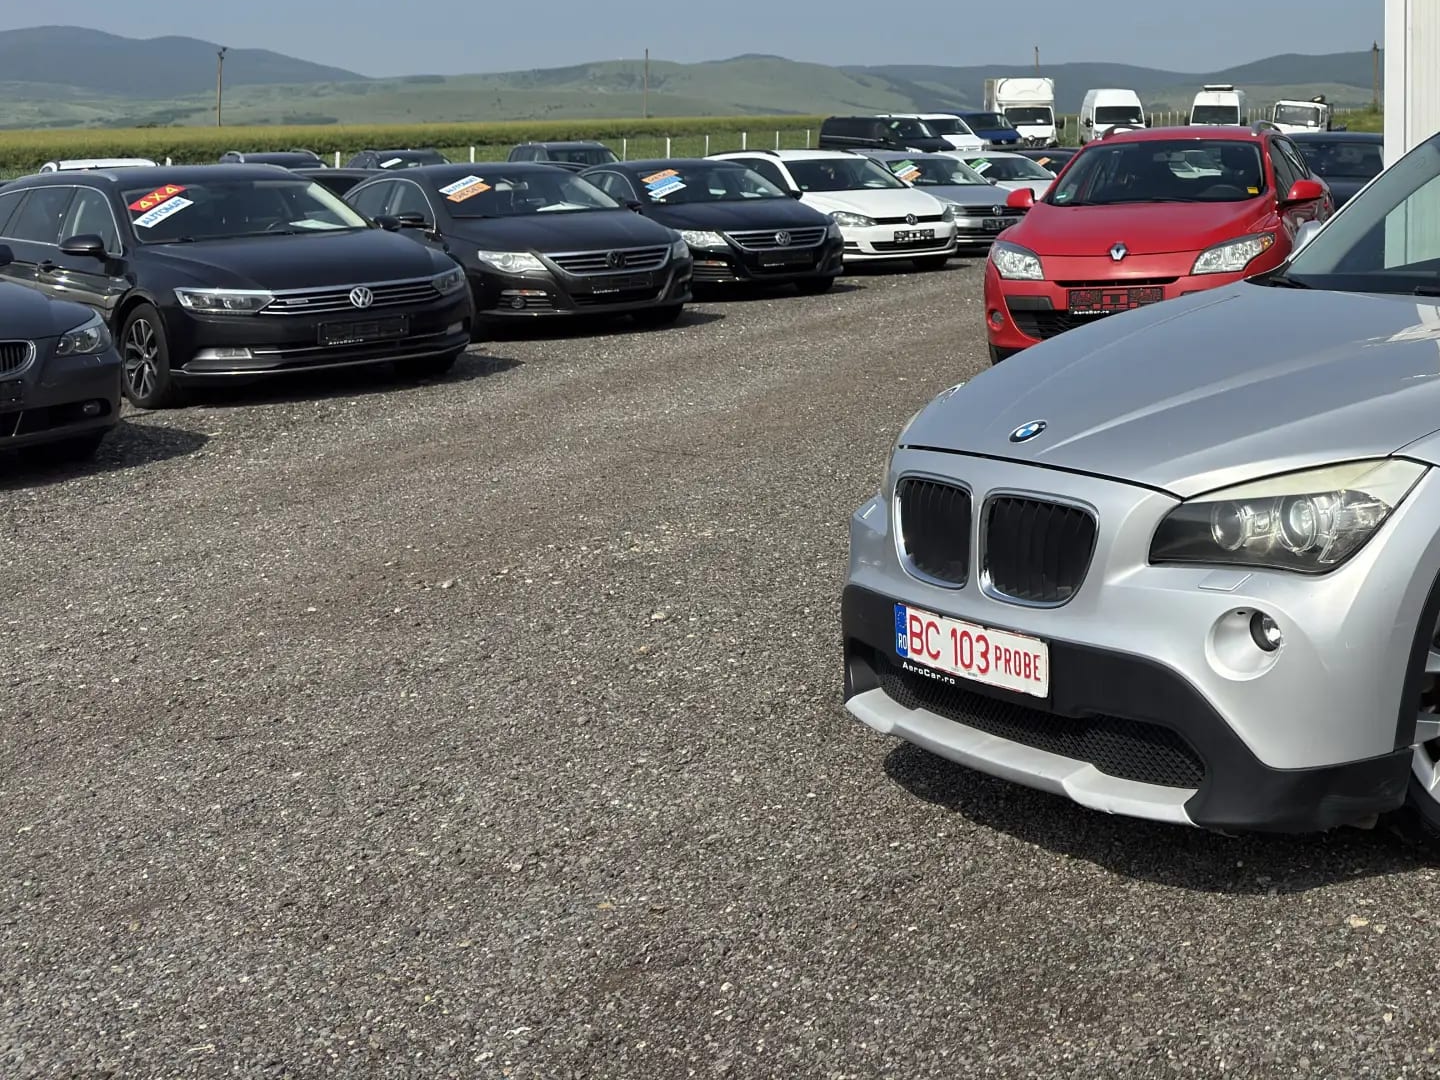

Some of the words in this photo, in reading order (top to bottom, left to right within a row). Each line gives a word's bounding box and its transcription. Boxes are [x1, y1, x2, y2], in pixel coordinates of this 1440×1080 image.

[898, 632, 908, 651] RO
[908, 614, 941, 661] BC
[950, 627, 990, 675] 103
[994, 644, 1041, 683] PROBE
[902, 661, 956, 686] AeroCar.ro
